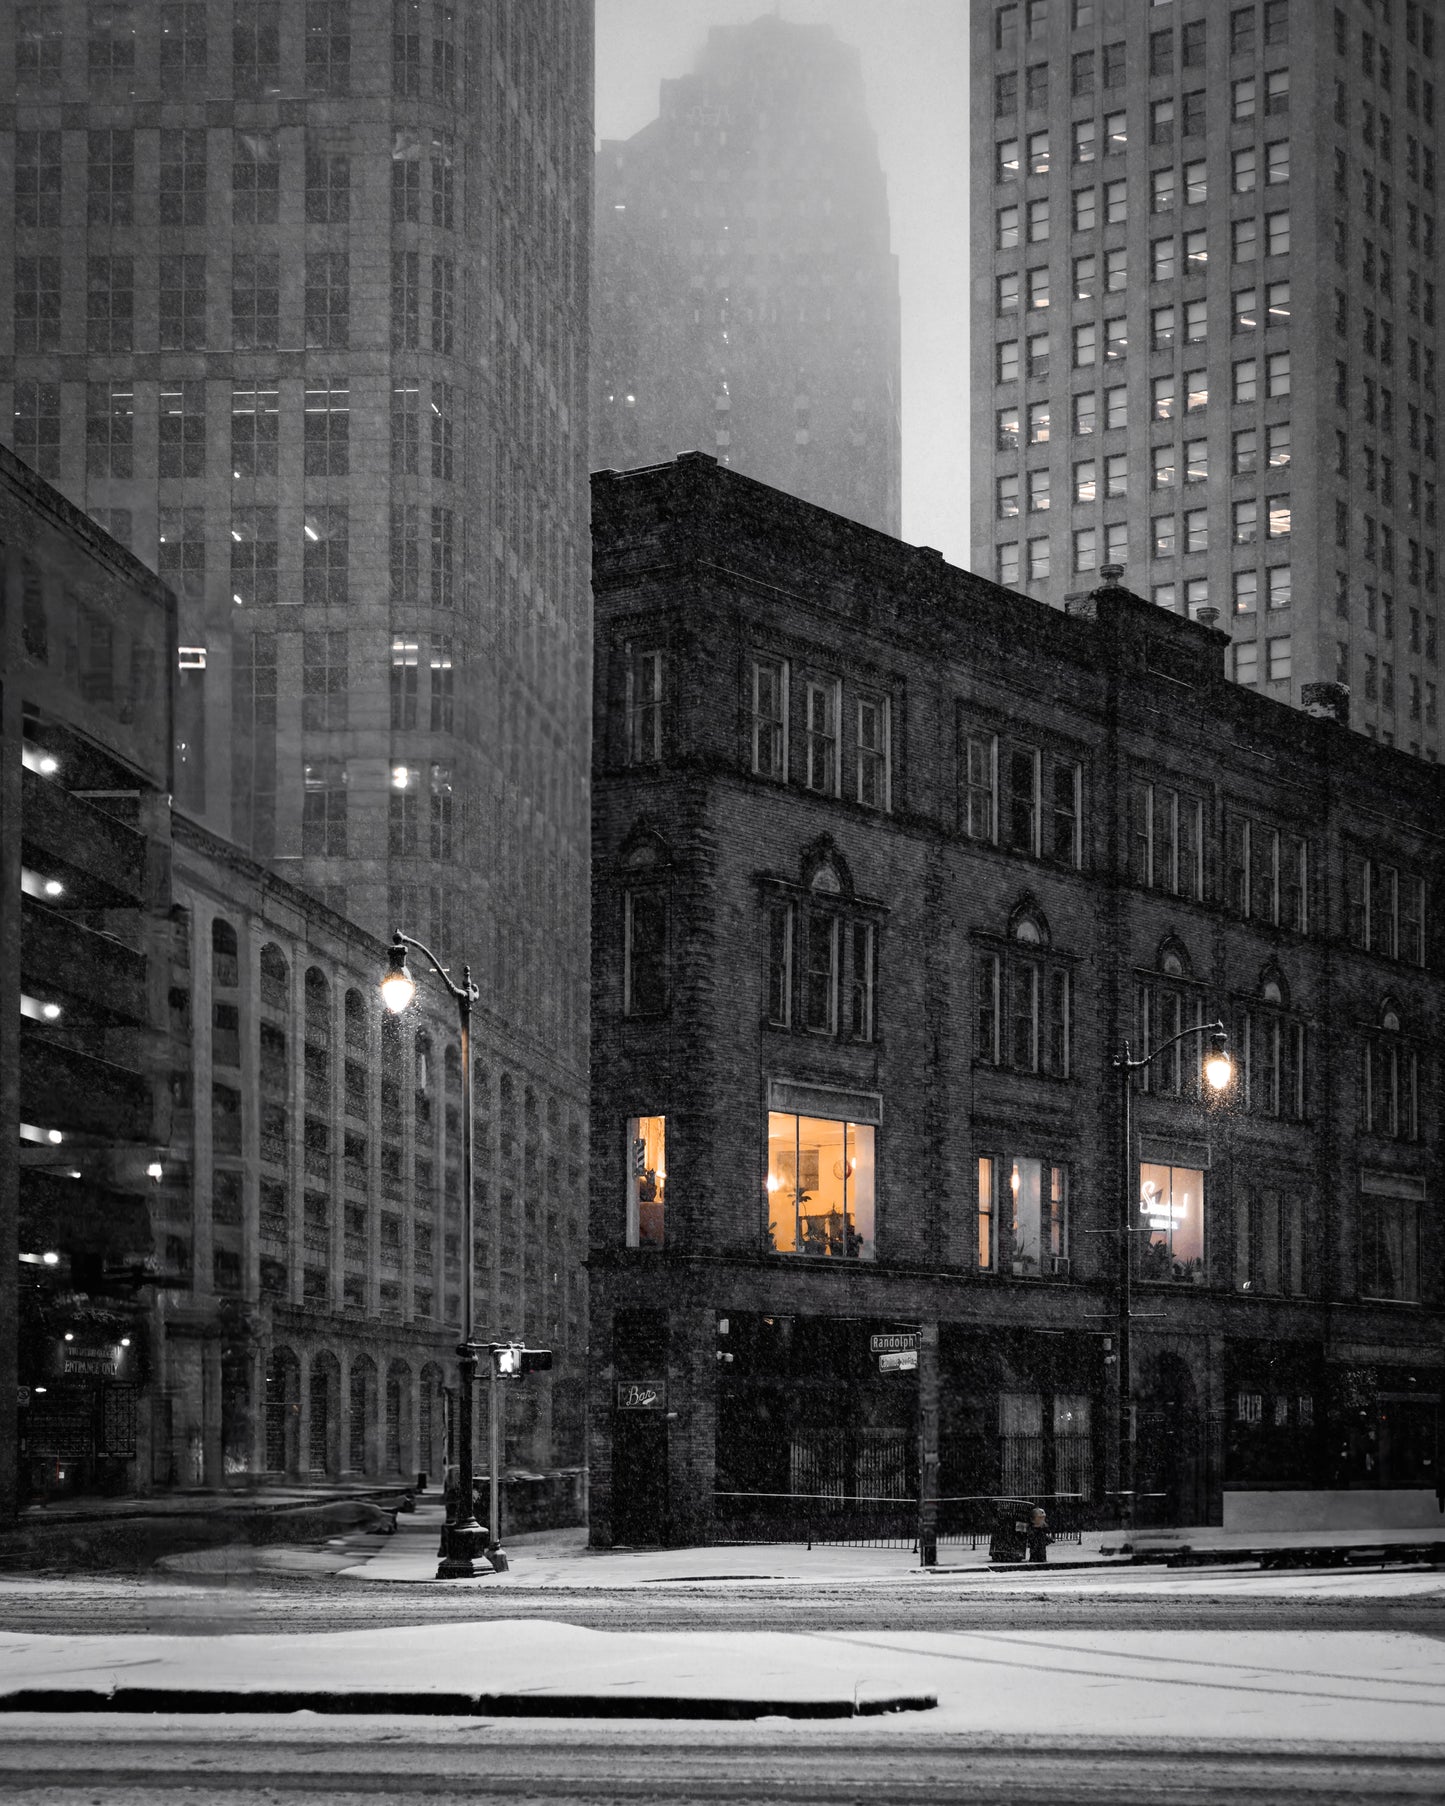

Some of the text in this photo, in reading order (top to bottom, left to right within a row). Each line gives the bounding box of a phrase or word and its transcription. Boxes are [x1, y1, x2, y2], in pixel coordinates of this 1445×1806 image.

[873, 1336, 914, 1350] Randolph
[64, 1360, 119, 1375] ENTRANCE ONLY
[626, 1385, 656, 1406] Bar
